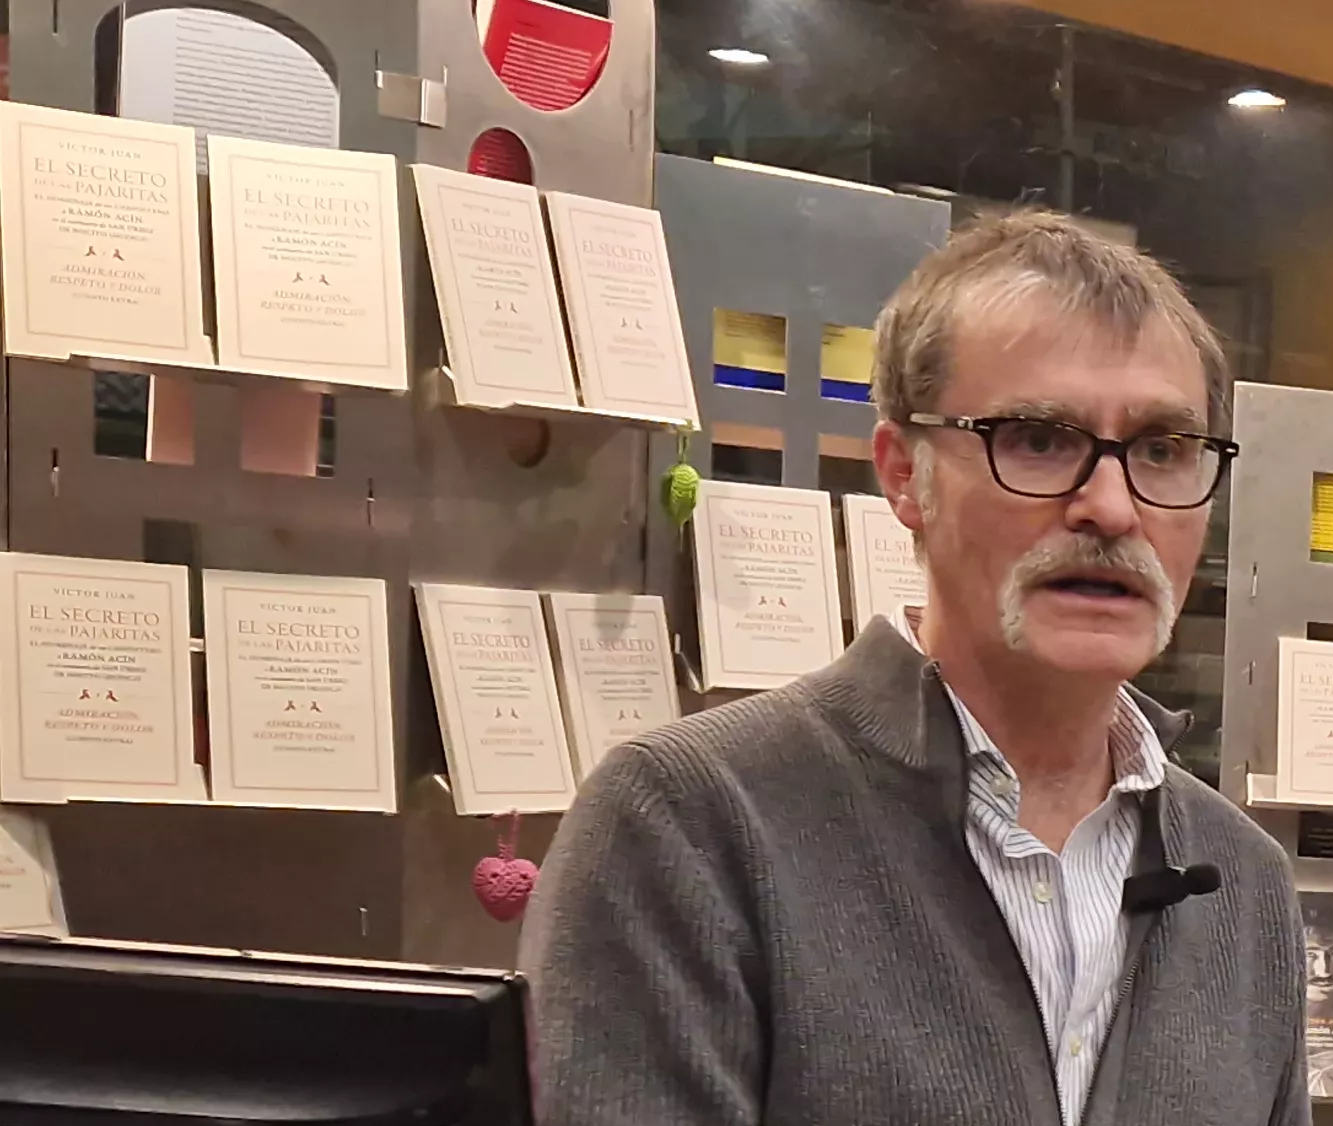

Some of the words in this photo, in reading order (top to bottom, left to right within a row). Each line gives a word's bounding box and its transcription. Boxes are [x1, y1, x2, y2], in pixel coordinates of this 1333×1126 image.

[34, 157, 58, 173] EL
[66, 161, 167, 187] SECRETO
[76, 181, 168, 203] PAJARITAS
[245, 188, 268, 204] EL
[273, 191, 369, 213] SECRETO
[30, 605, 53, 620] EL
[61, 607, 160, 627] SECRETO
[70, 625, 160, 642] PAJARITAS
[238, 620, 260, 634] EL
[266, 622, 360, 639] SECRETO
